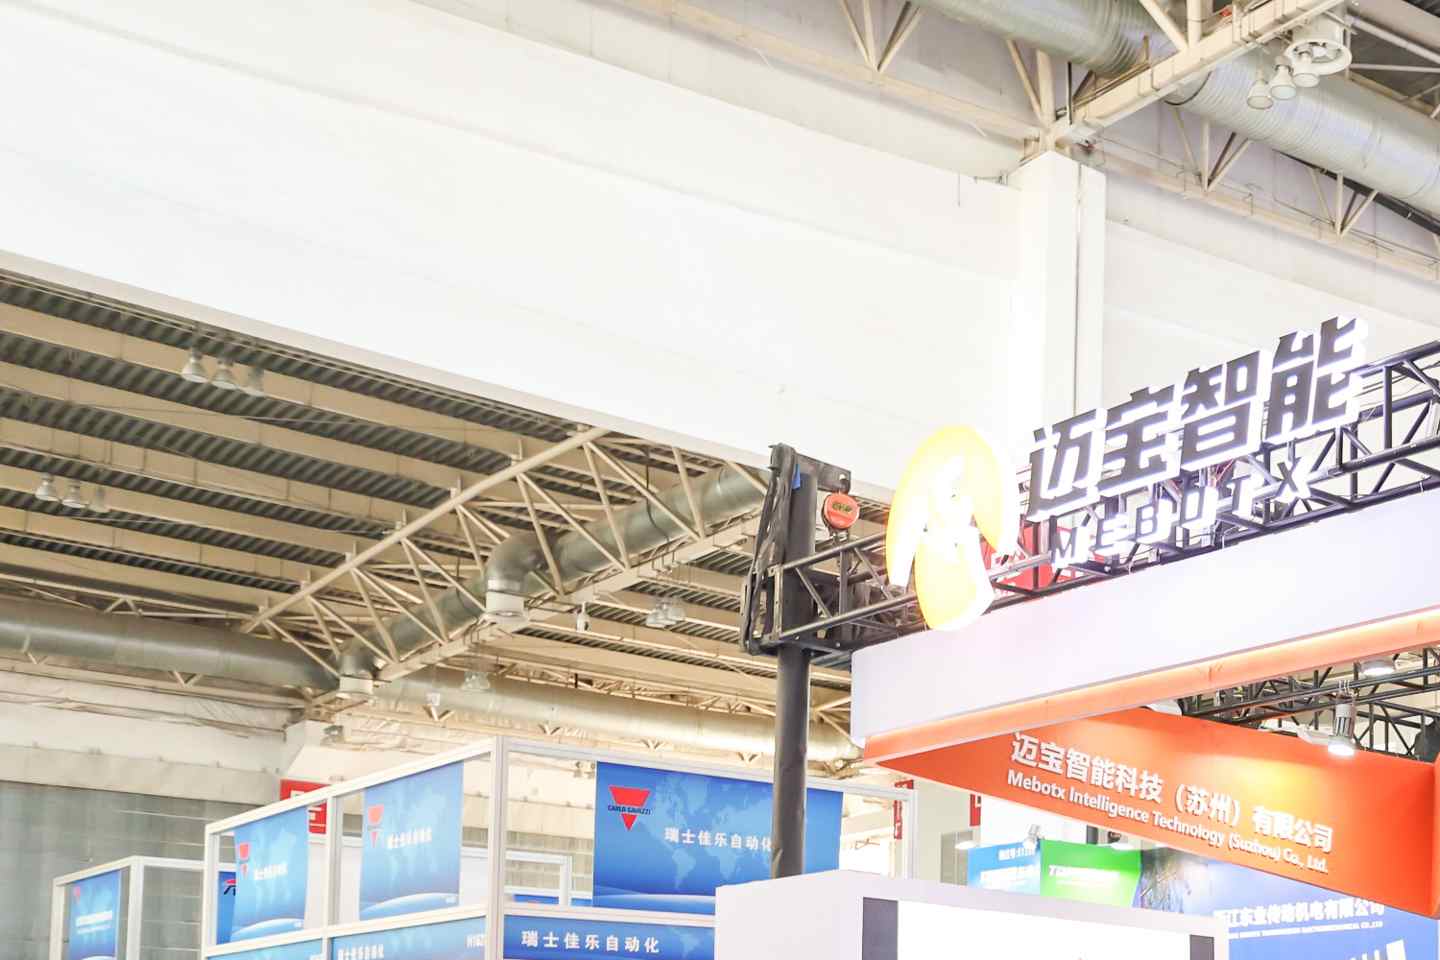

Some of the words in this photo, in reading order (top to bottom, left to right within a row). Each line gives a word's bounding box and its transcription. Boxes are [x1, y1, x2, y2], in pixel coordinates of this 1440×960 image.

[1026, 316, 1362, 516] 迈宝智能
[664, 826, 773, 851] 瑞士佳乐自动化
[1006, 768, 1067, 800] Mebotx
[1069, 788, 1150, 824] Intelligence
[1152, 812, 1226, 849] Technology
[1228, 831, 1283, 863] (Suzhou)
[1306, 853, 1329, 874] Ltd.
[1011, 731, 1334, 853] 迈宝智能科技（苏州）有限公司
[521, 929, 660, 953] 瑞士佳乐自动化
